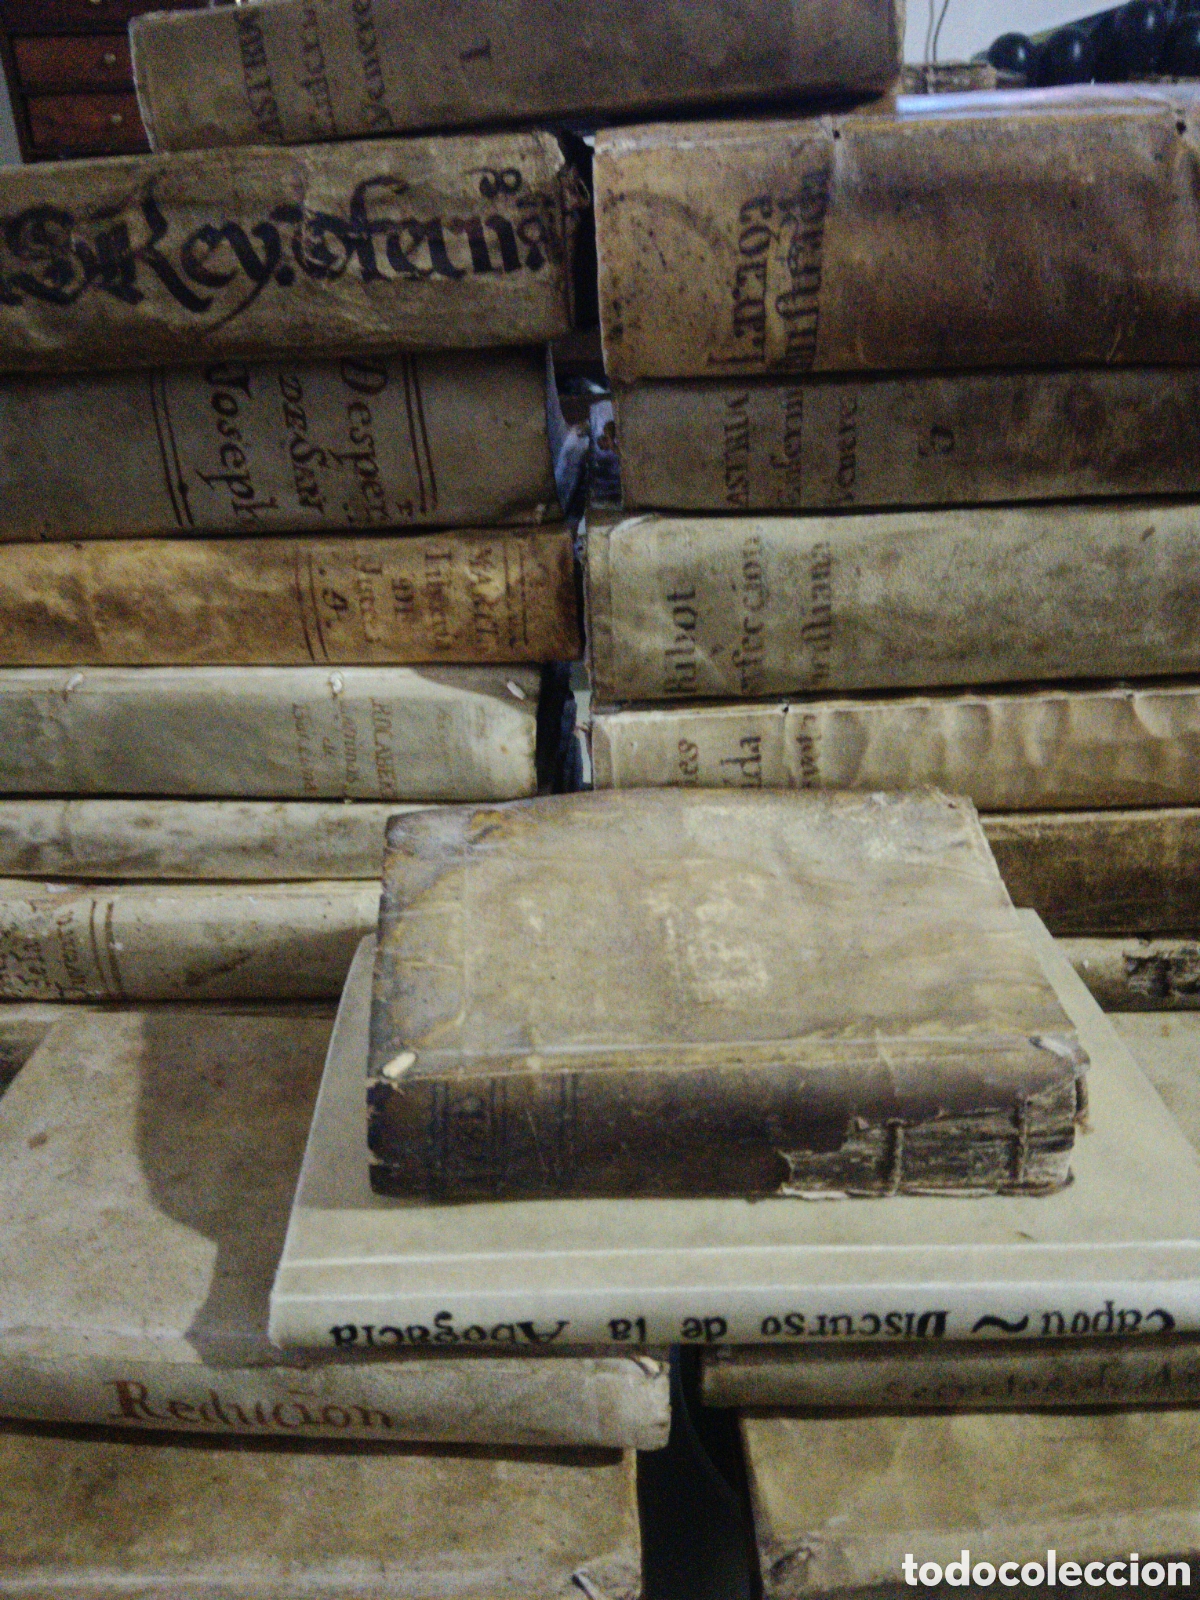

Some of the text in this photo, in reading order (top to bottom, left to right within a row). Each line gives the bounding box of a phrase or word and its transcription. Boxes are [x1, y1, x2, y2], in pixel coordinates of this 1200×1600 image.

[608, 1317, 647, 1344] la
[680, 1317, 729, 1344] de
[759, 1310, 950, 1338] Discurso
